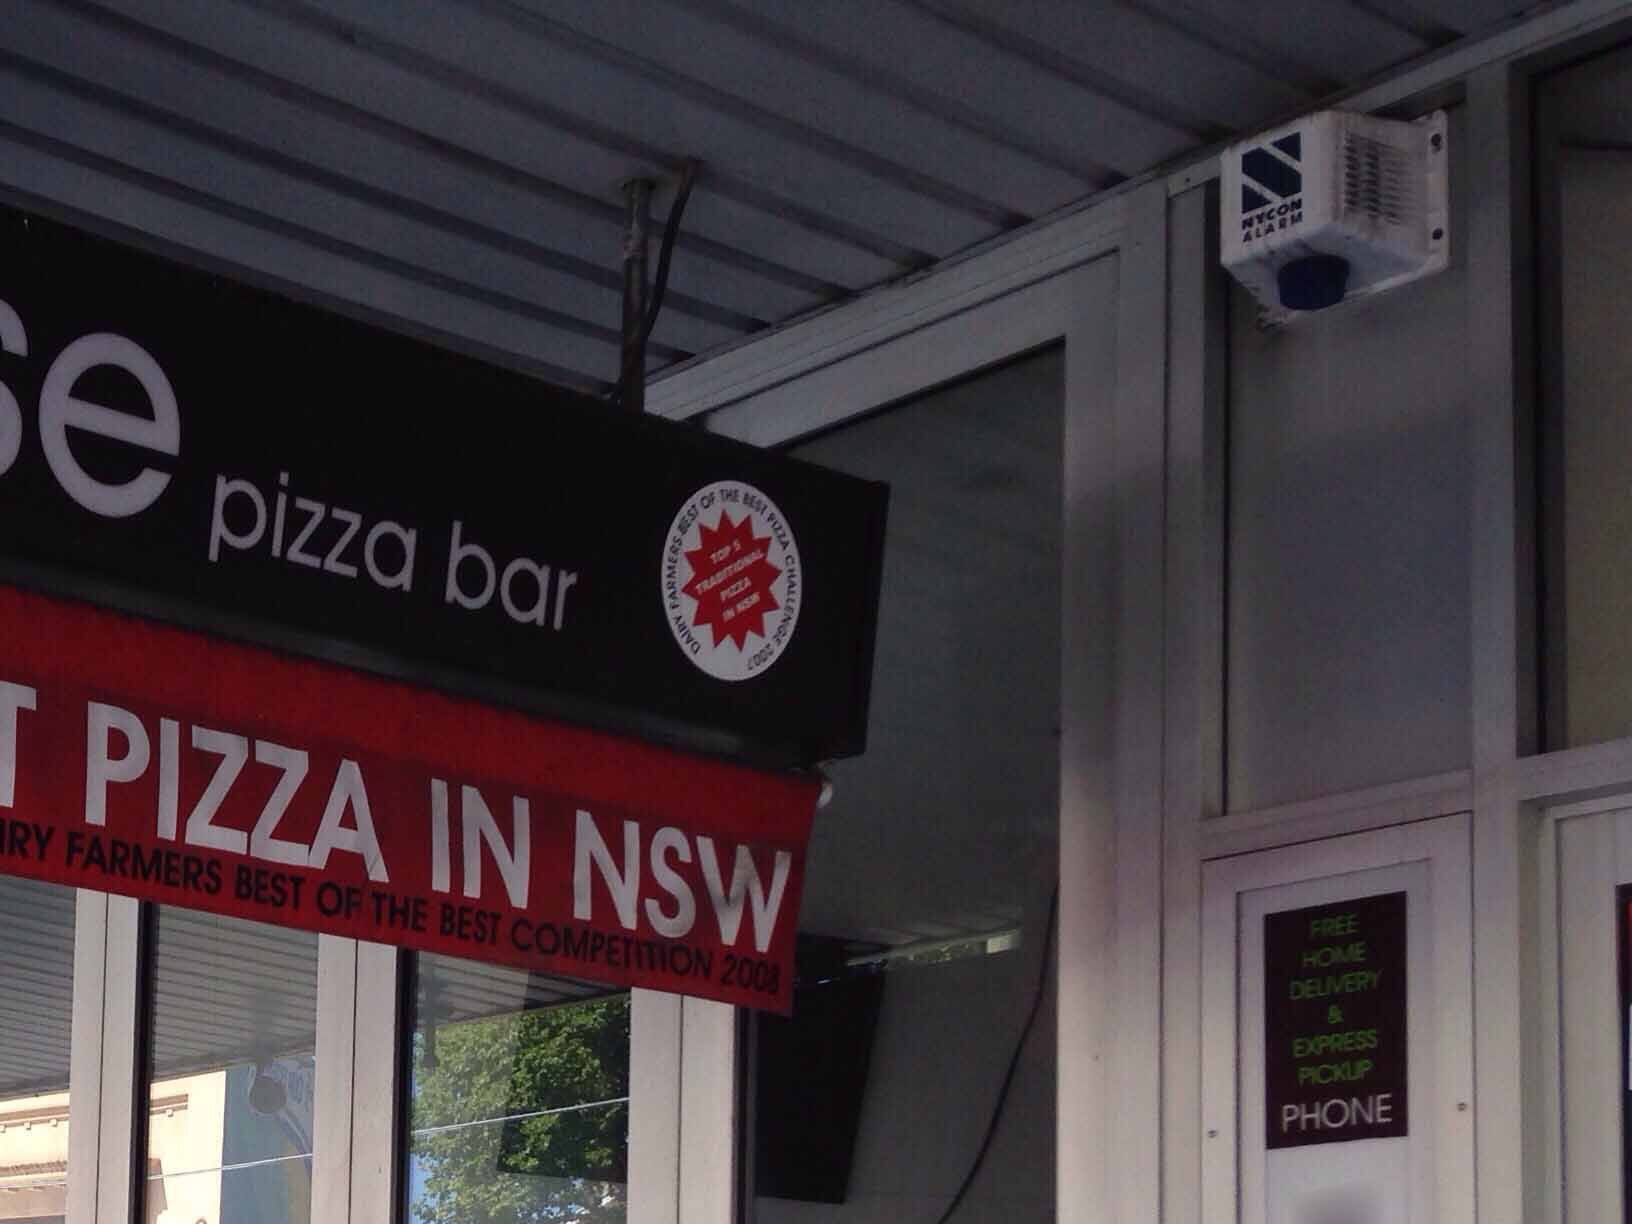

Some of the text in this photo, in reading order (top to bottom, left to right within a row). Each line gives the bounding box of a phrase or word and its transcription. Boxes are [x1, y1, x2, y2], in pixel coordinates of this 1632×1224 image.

[1242, 211, 1303, 243] ALARM
[700, 490, 717, 509] OF
[719, 488, 741, 501] THE
[677, 503, 699, 536] BEST
[766, 511, 789, 551] PIZZA
[208, 470, 578, 631] pizza bar
[665, 535, 684, 611] FARMERS
[771, 553, 799, 647] CHALLENGE
[672, 614, 702, 655] DAIRY
[84, 700, 389, 882] PIZZA
[431, 777, 530, 908] IN
[573, 809, 792, 953] NSW
[65, 830, 224, 898] FARMERS
[235, 862, 306, 909] BEST
[316, 881, 363, 919] OF
[370, 891, 428, 932] THE
[440, 905, 503, 943] BEST
[509, 918, 716, 981] COMPETITION
[719, 954, 780, 995] 2008
[1310, 913, 1361, 940] FREE
[1302, 941, 1368, 969] HOME
[1289, 969, 1383, 1000] DELIVERY
[1327, 1004, 1344, 1025] &
[1292, 1028, 1378, 1059] EXPRESS
[1298, 1058, 1373, 1086] PICKUP
[1281, 1092, 1394, 1133] PHONE
